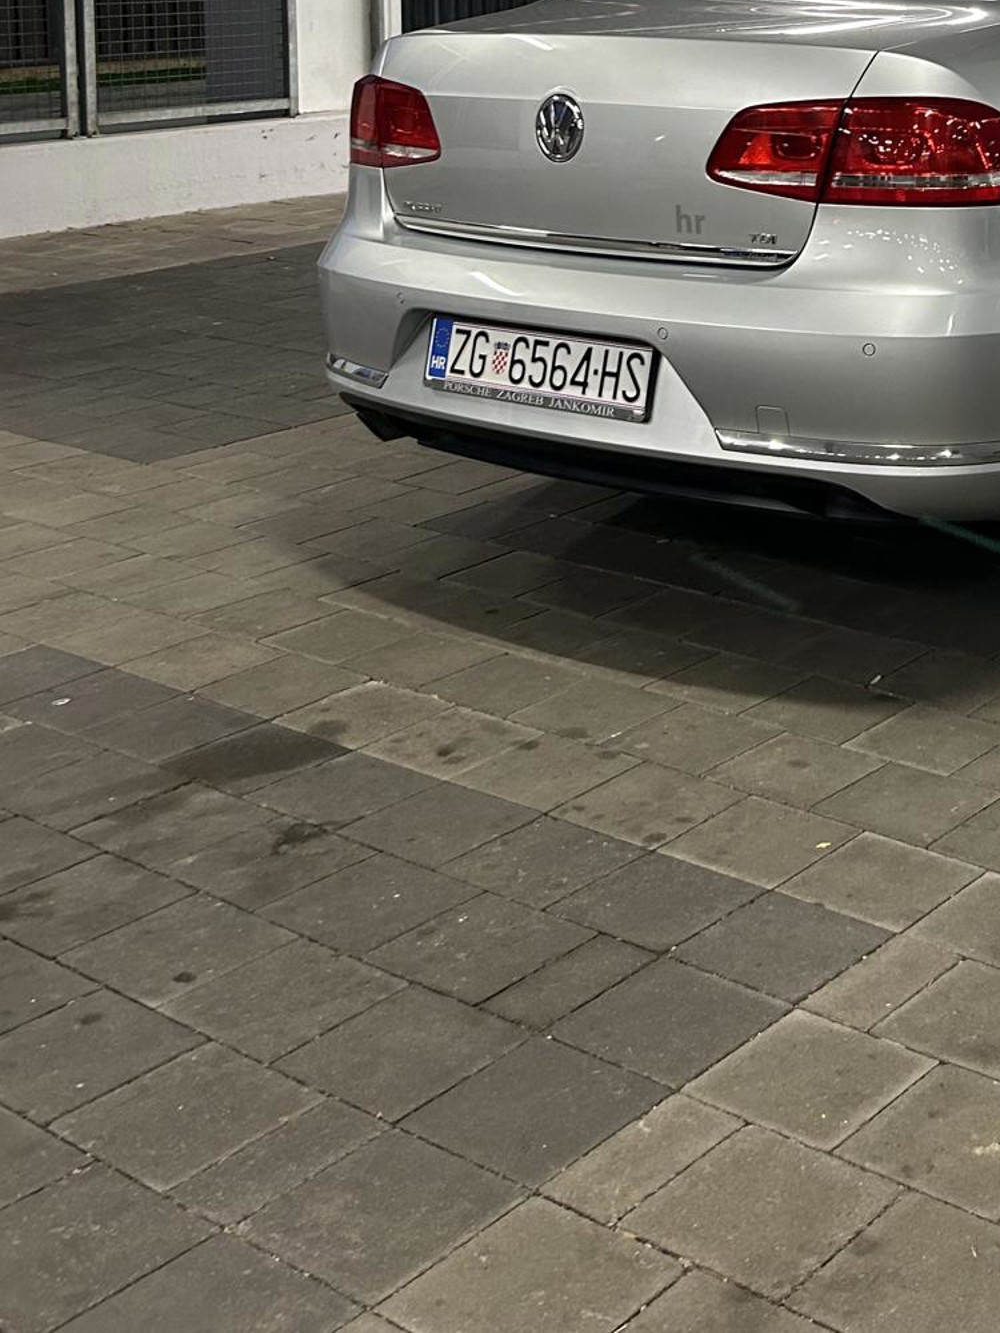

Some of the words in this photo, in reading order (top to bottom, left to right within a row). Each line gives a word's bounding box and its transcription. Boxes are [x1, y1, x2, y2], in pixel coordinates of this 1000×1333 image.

[675, 204, 706, 234] hr
[431, 355, 447, 370] HR
[450, 328, 490, 378] ZG
[443, 382, 492, 397] PORSCHE
[497, 389, 544, 405] ZAGREB
[549, 396, 616, 417] JANKOMIR
